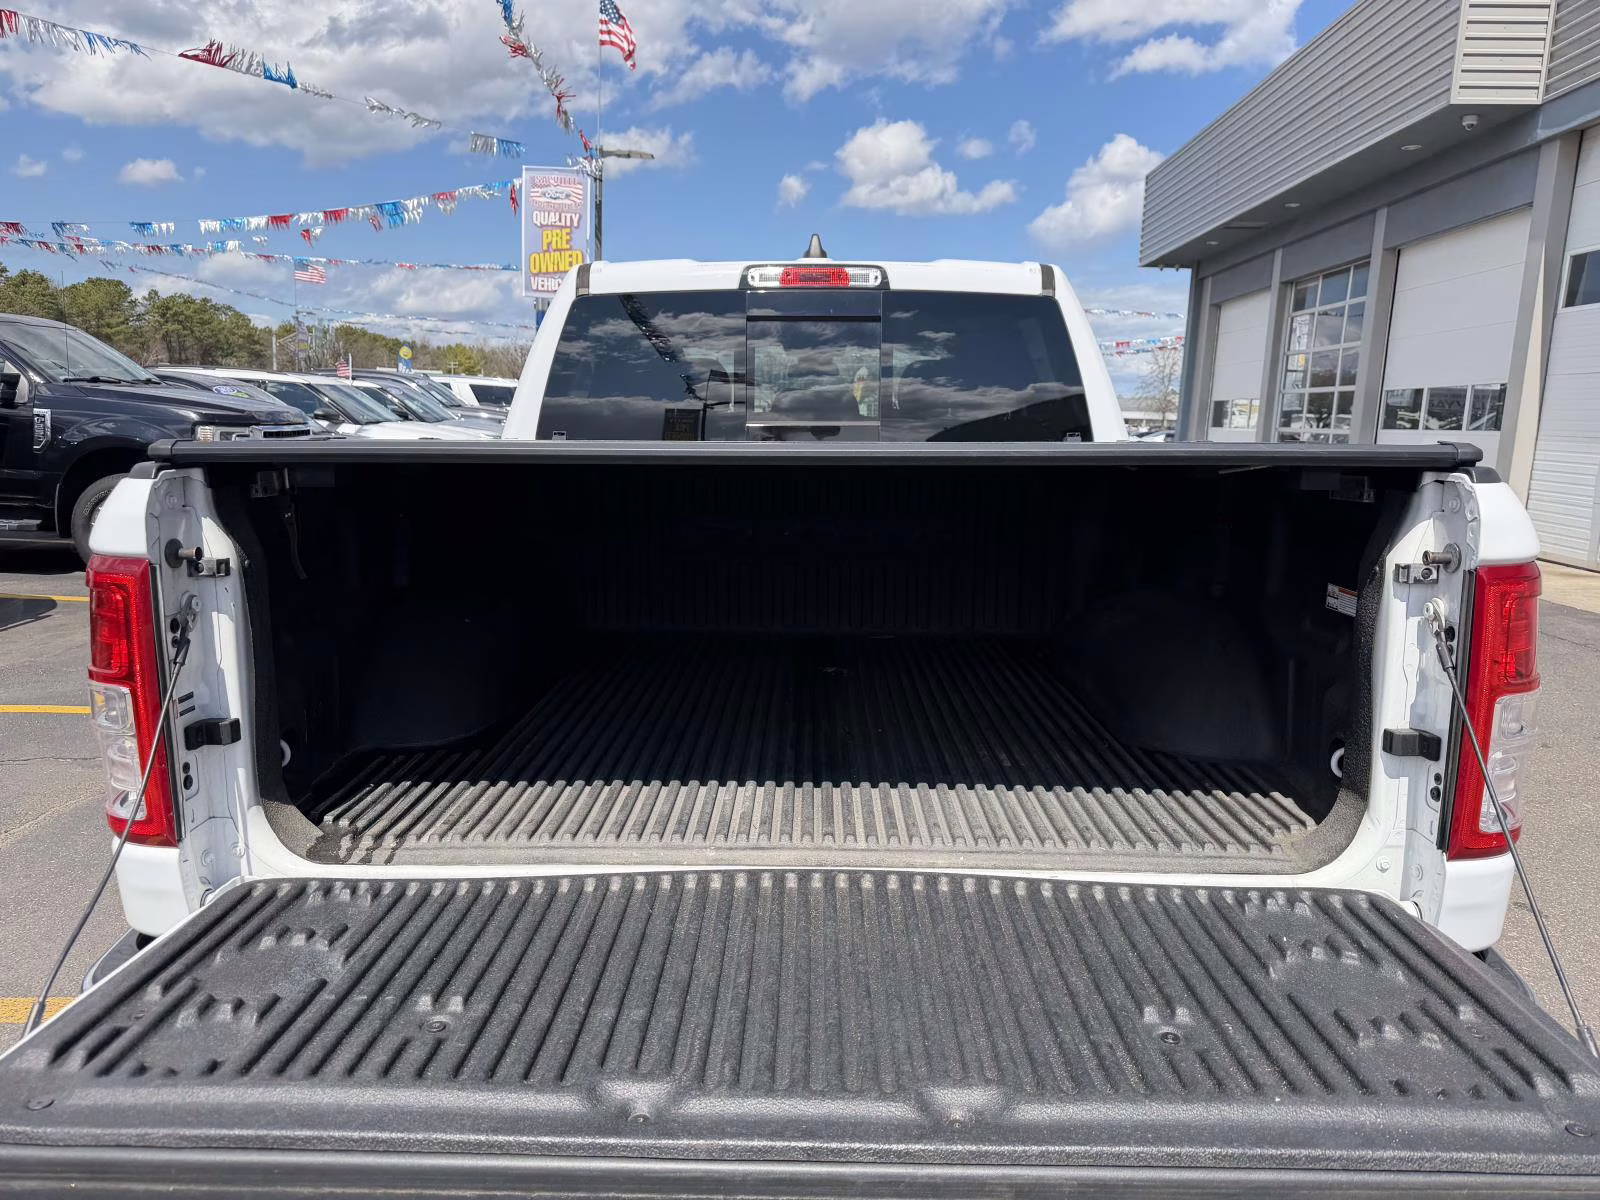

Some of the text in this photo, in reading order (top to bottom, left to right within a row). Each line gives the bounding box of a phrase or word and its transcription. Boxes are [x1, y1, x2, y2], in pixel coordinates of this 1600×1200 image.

[532, 210, 580, 227] QUALITY
[542, 228, 571, 251] PRE
[529, 250, 583, 274] OWNED
[530, 276, 562, 291] VEHIC
